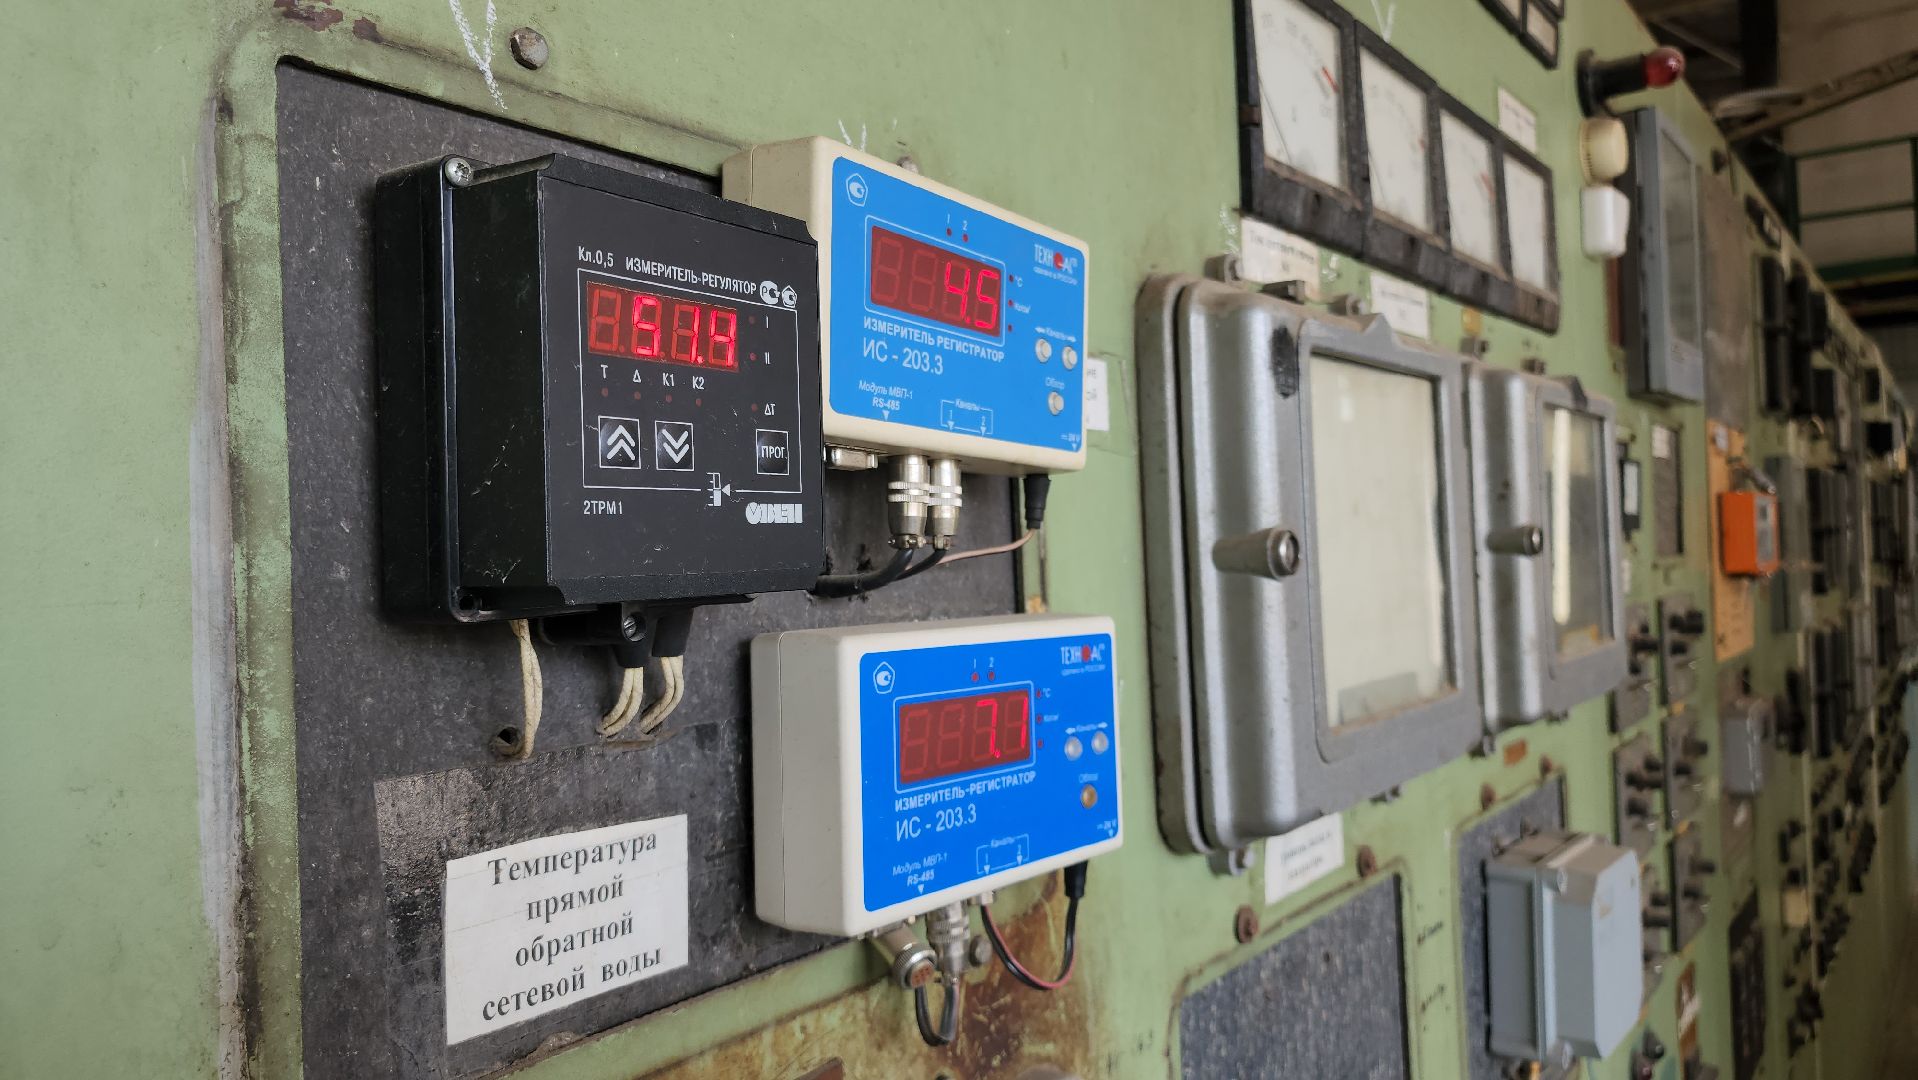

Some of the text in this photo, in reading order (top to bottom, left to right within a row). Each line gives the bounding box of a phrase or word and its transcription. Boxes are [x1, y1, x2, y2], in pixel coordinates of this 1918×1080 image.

[577, 245, 757, 296] Кл.0,5 ИЗМЕРИТЕЛЬ-РЕГУЛЯТОР
[863, 316, 1005, 363] ИЗМЕРИТЕЛЬ РЕГИСТРАТОР
[863, 336, 888, 363] ИС
[902, 348, 944, 375] 203.3
[872, 396, 901, 411] RS-485
[583, 500, 624, 515] 2ТРМ1
[894, 771, 1037, 813] ИЗМЕРИТЕЛЬ-РЕГИСТРАТОР
[896, 816, 922, 842] ИС
[936, 803, 977, 833] 203.3
[488, 832, 657, 886] Температура
[527, 873, 625, 924] прямой
[515, 911, 634, 967] обратной
[482, 947, 662, 1021] сетевой воды
